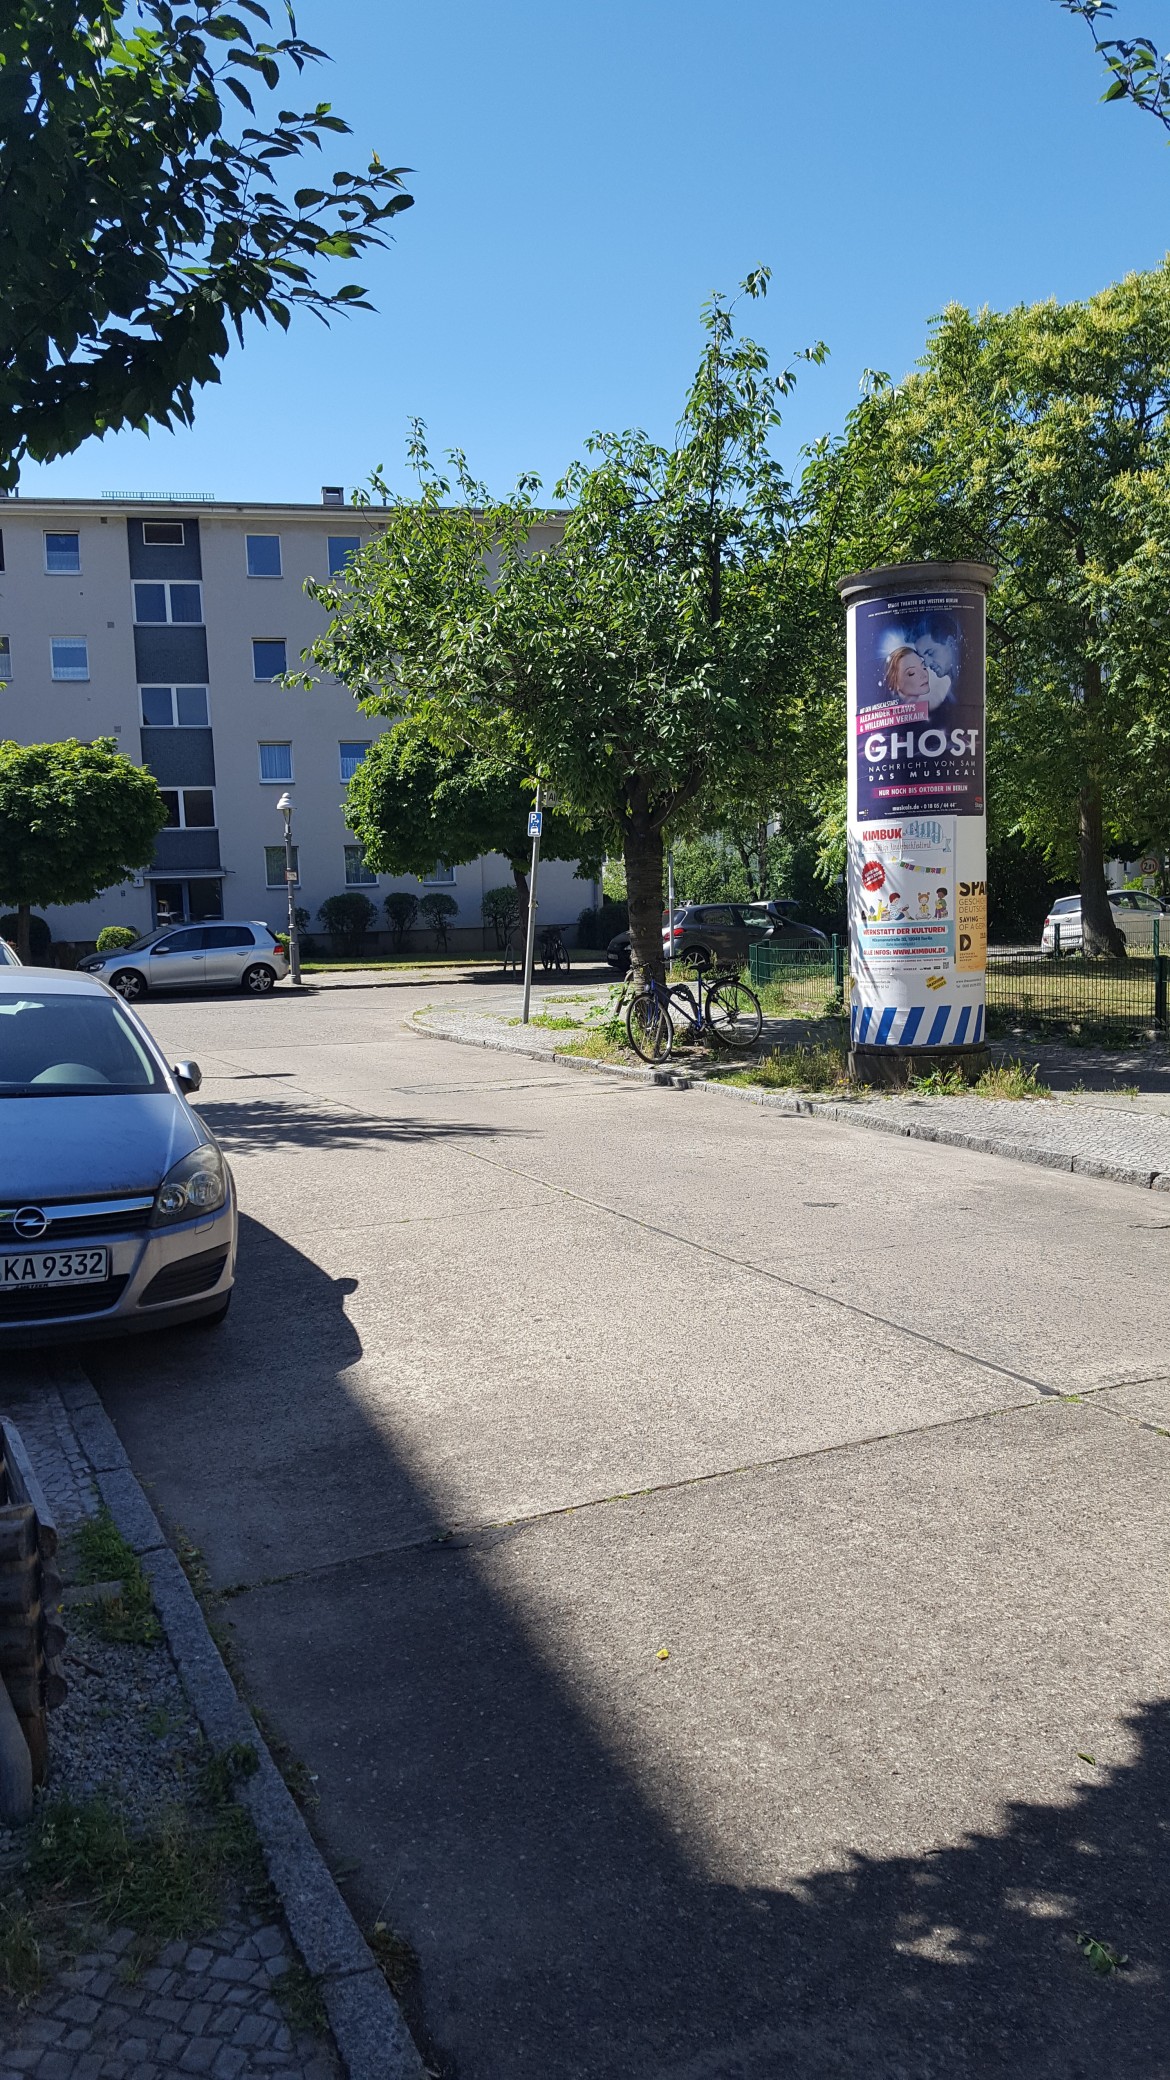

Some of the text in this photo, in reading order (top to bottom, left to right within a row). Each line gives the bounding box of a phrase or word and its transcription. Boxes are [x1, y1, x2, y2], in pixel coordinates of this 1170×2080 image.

[860, 704, 916, 724] ALEXANDER KLAWS
[865, 718, 894, 731] WILLEMIJN
[896, 712, 925, 723] VERKAIK
[864, 728, 978, 762] GHOST
[869, 761, 928, 772] NACHRICHT
[869, 770, 976, 781] DAS MUSICAL
[531, 814, 537, 823] P
[863, 828, 902, 841] KIMBUK
[4, 1252, 103, 1281] KA 9332
